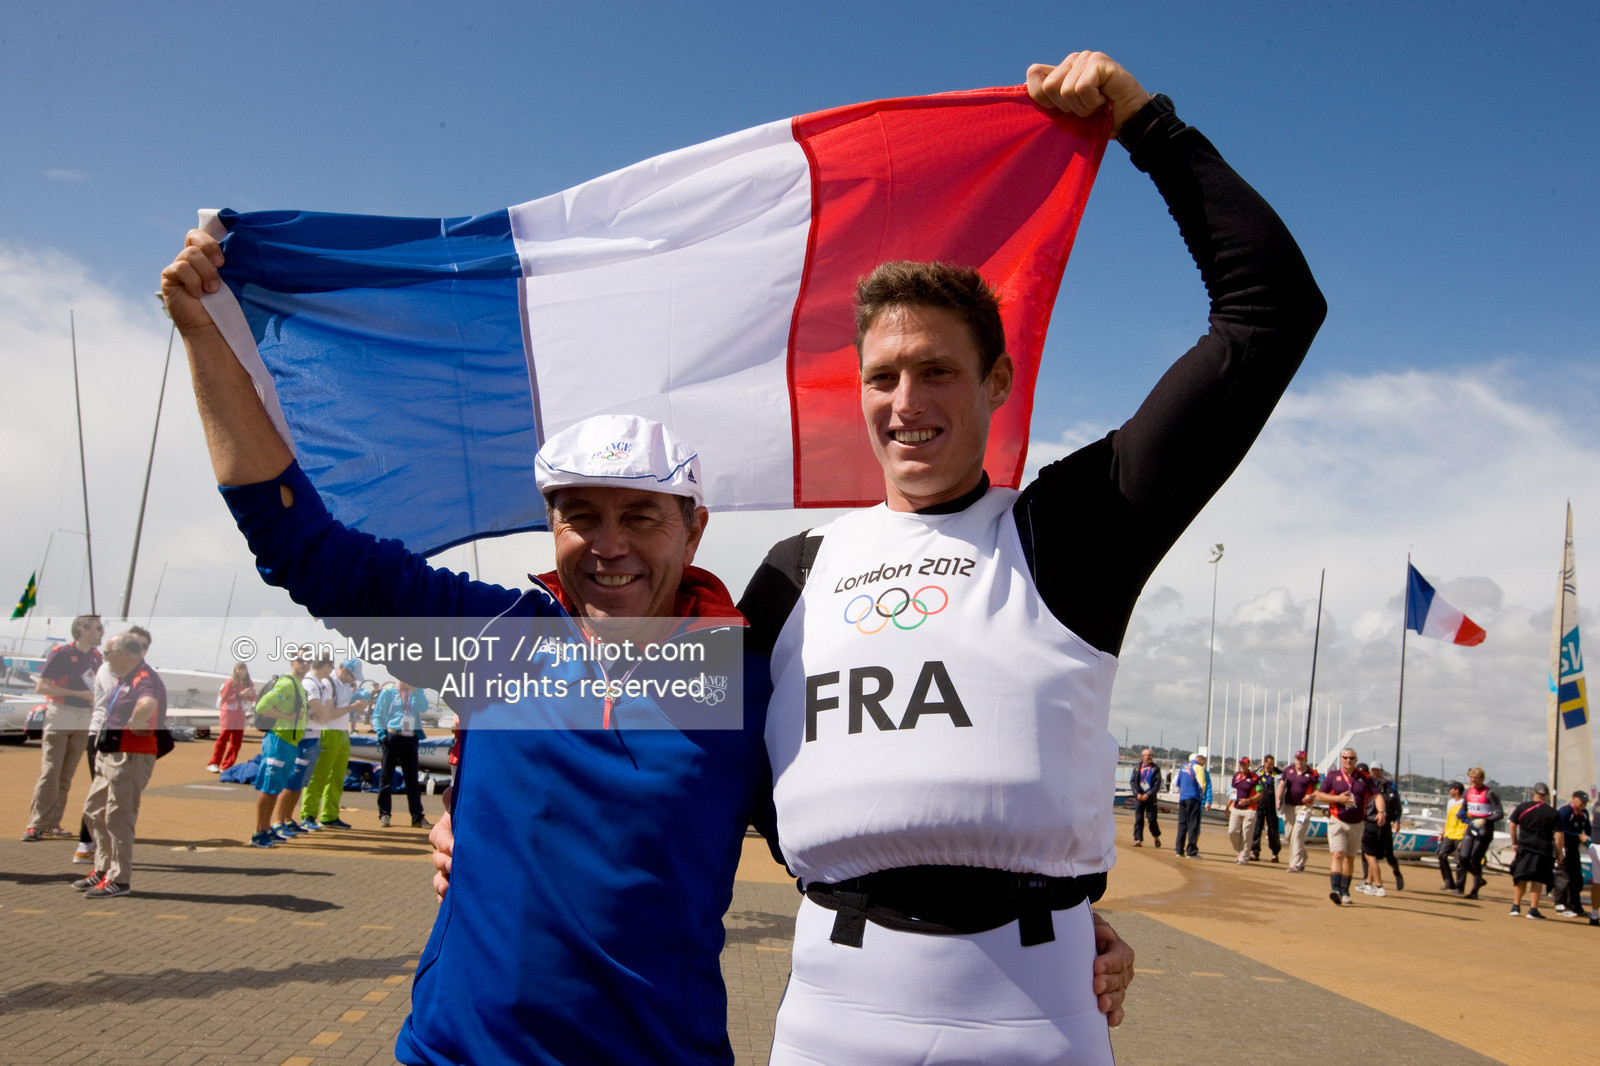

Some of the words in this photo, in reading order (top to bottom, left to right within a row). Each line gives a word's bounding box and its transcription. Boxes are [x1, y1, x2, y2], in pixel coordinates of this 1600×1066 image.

[834, 563, 912, 594] London
[918, 557, 976, 577] 2012
[805, 661, 973, 743] FRA
